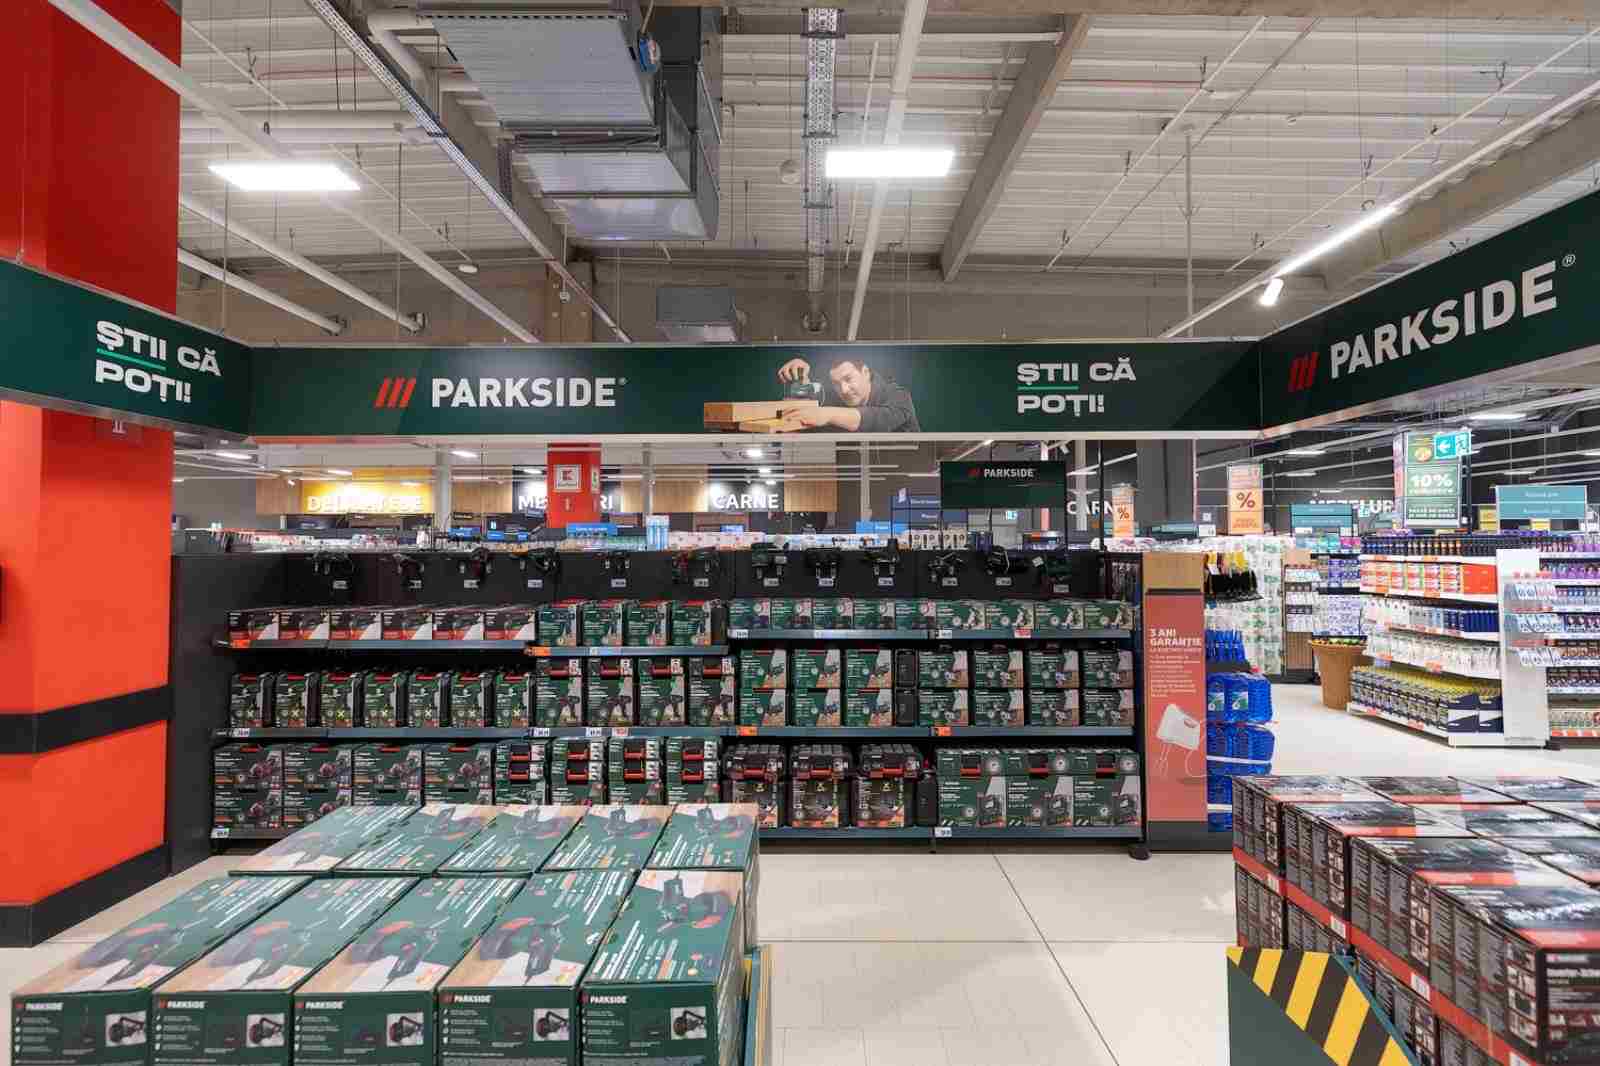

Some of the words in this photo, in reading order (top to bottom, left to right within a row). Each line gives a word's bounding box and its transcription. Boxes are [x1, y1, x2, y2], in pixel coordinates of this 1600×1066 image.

[177, 346, 222, 376] CĂ
[1089, 356, 1137, 381] CĂ
[95, 359, 192, 403] POȚI!
[1017, 394, 1105, 417] POȚI!
[711, 493, 779, 509] CARNE
